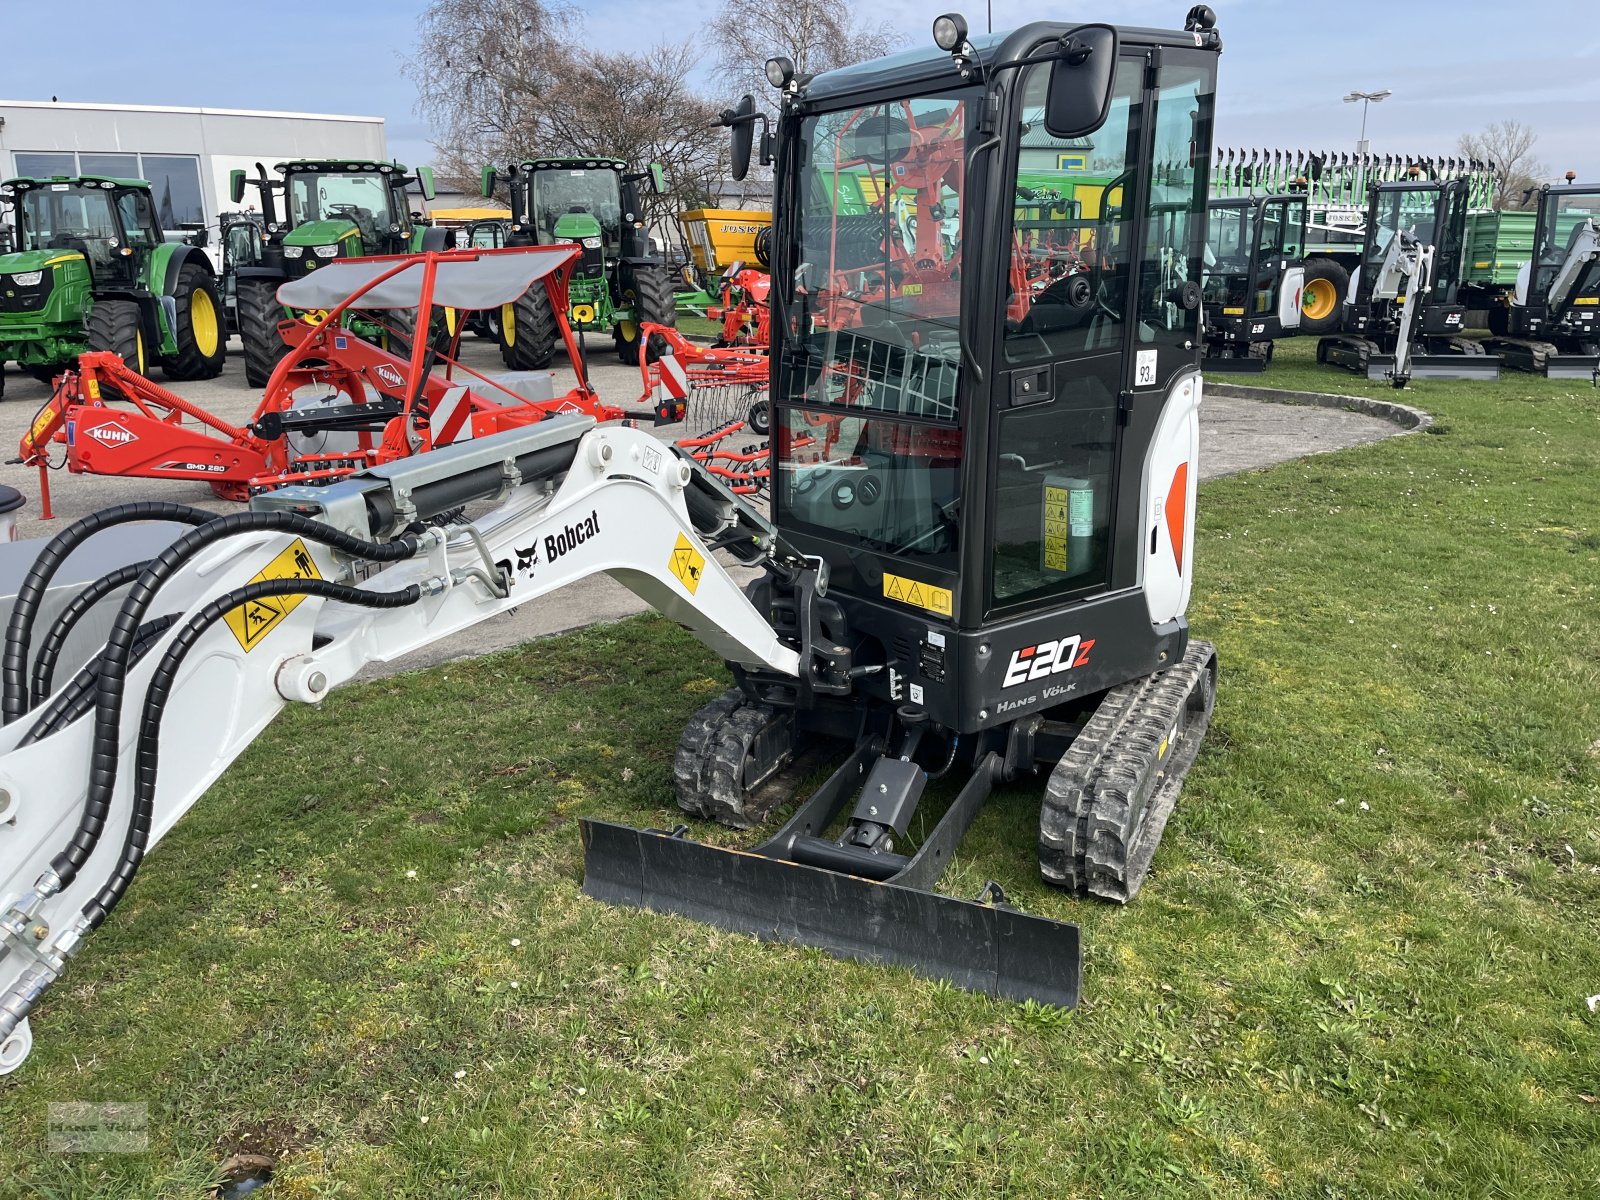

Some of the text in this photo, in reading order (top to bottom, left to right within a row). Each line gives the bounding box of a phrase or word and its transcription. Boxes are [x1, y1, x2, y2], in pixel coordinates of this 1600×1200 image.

[378, 367, 401, 385] KUHN
[1140, 365, 1150, 383] 93
[93, 428, 130, 442] KUHN
[207, 464, 225, 472] 280
[544, 509, 600, 564] Bobcat
